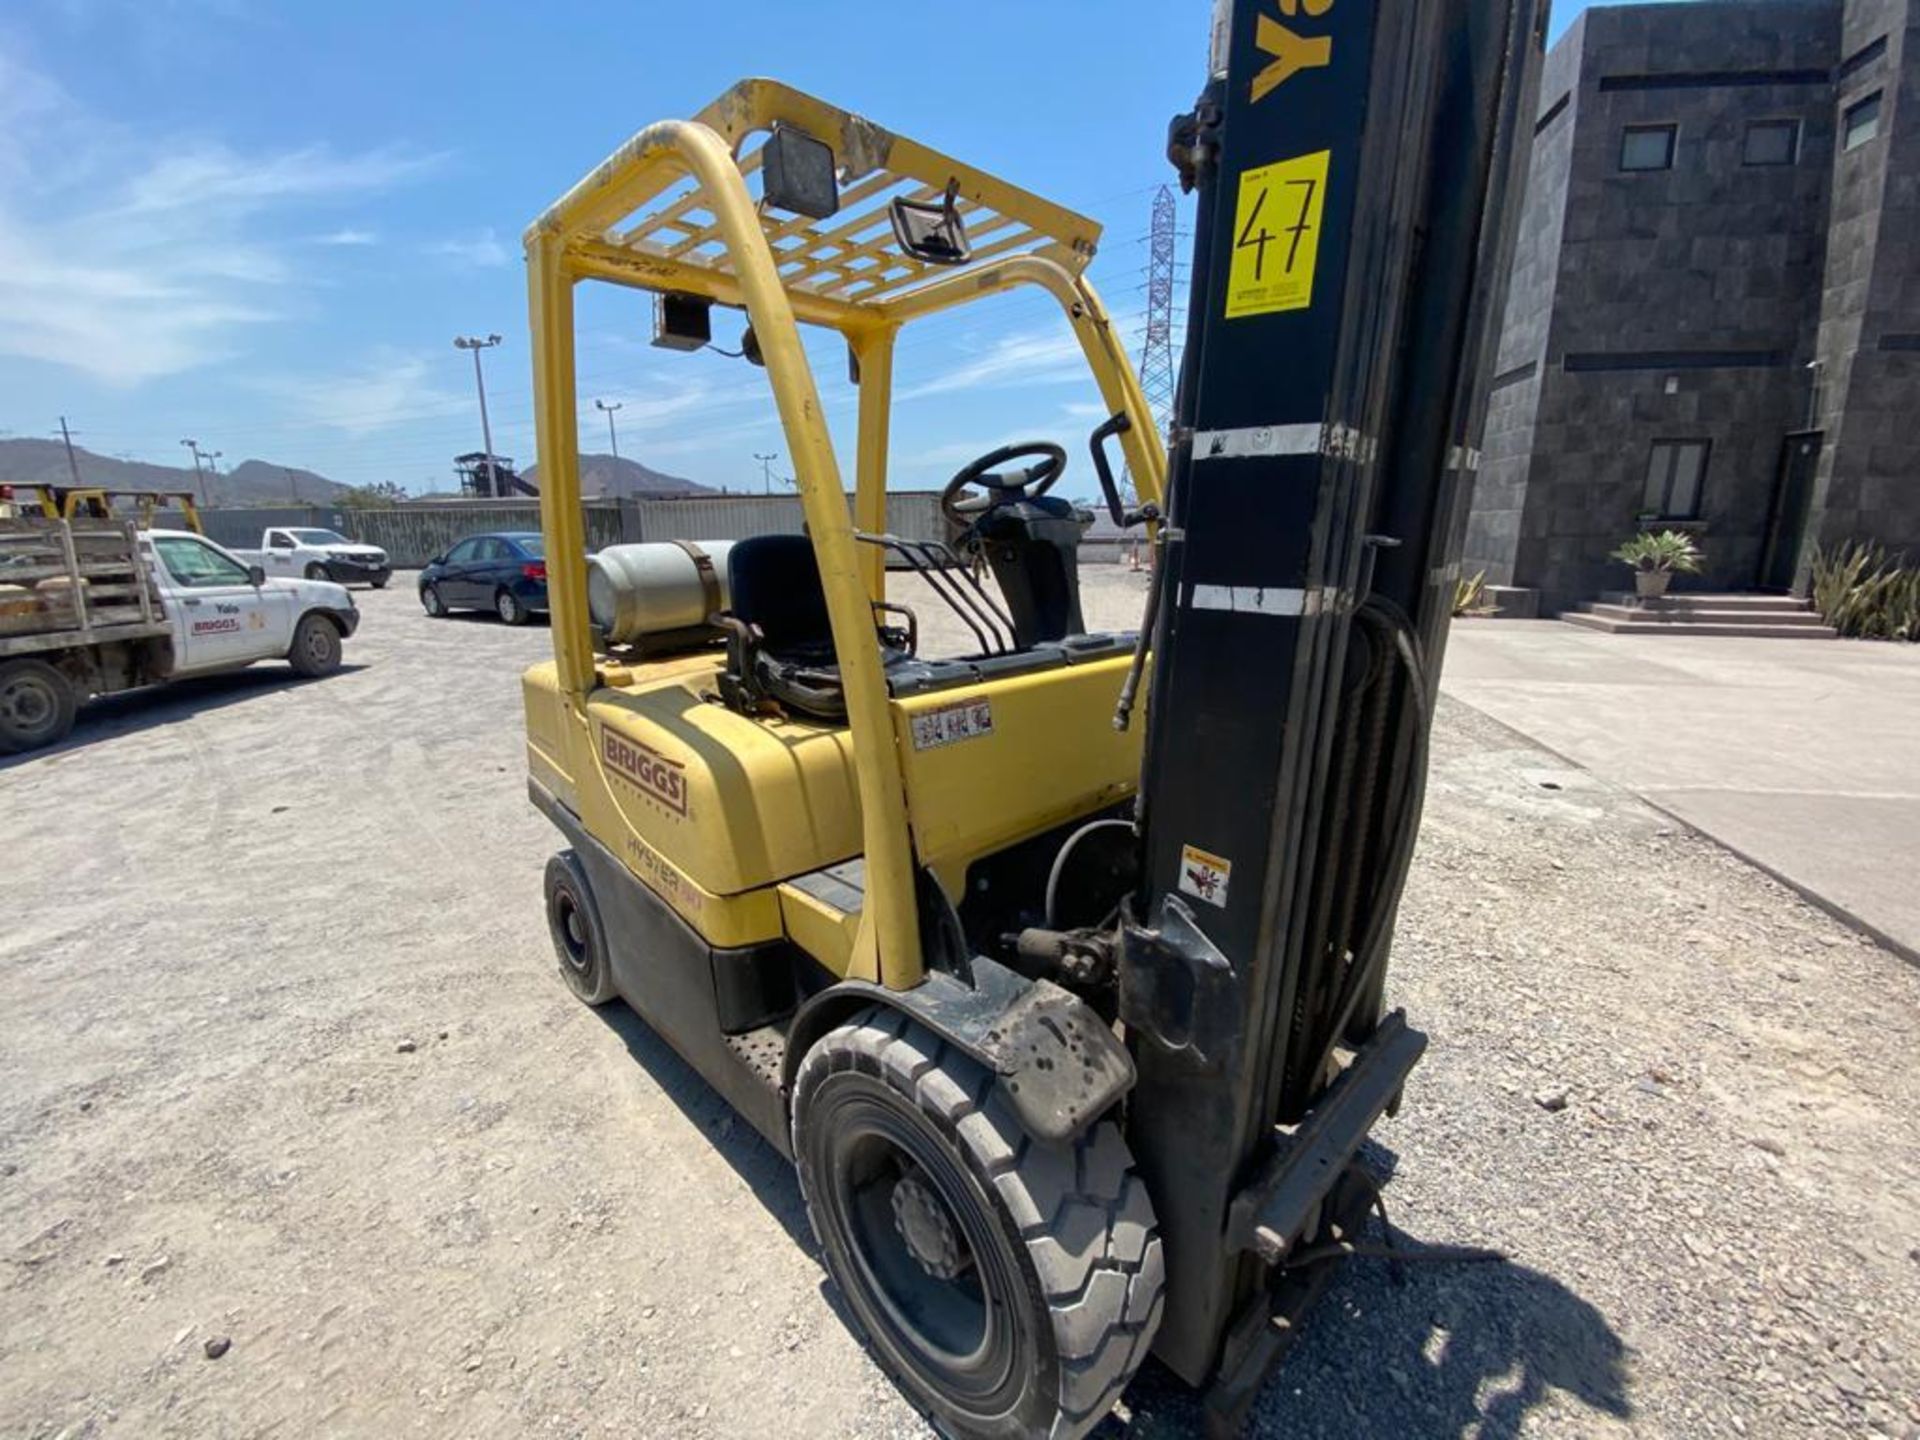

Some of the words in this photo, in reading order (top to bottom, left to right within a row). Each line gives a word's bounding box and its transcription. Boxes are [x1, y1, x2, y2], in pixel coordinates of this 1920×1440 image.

[1237, 180, 1316, 281] 47
[194, 619, 236, 631] BRIGGS
[606, 735, 681, 800] BRIGGS
[627, 839, 679, 891] HYSTER
